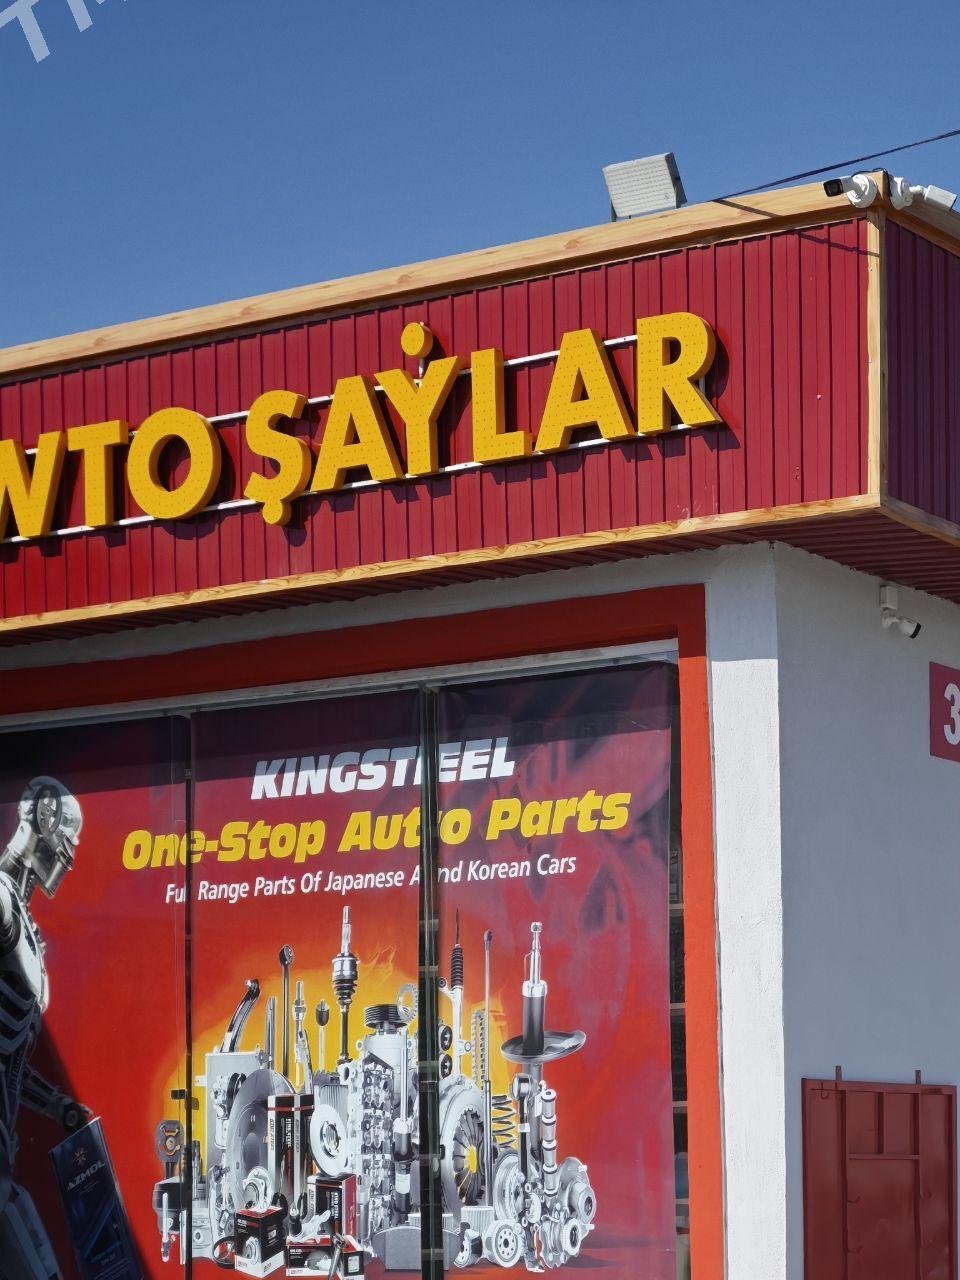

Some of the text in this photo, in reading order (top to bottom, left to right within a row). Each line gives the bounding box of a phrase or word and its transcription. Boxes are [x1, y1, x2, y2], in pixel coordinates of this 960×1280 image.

[122, 790, 631, 870] One-Stop Auto Parts
[165, 854, 577, 904] Ful Range Parts Of Japanese And Korean Cars
